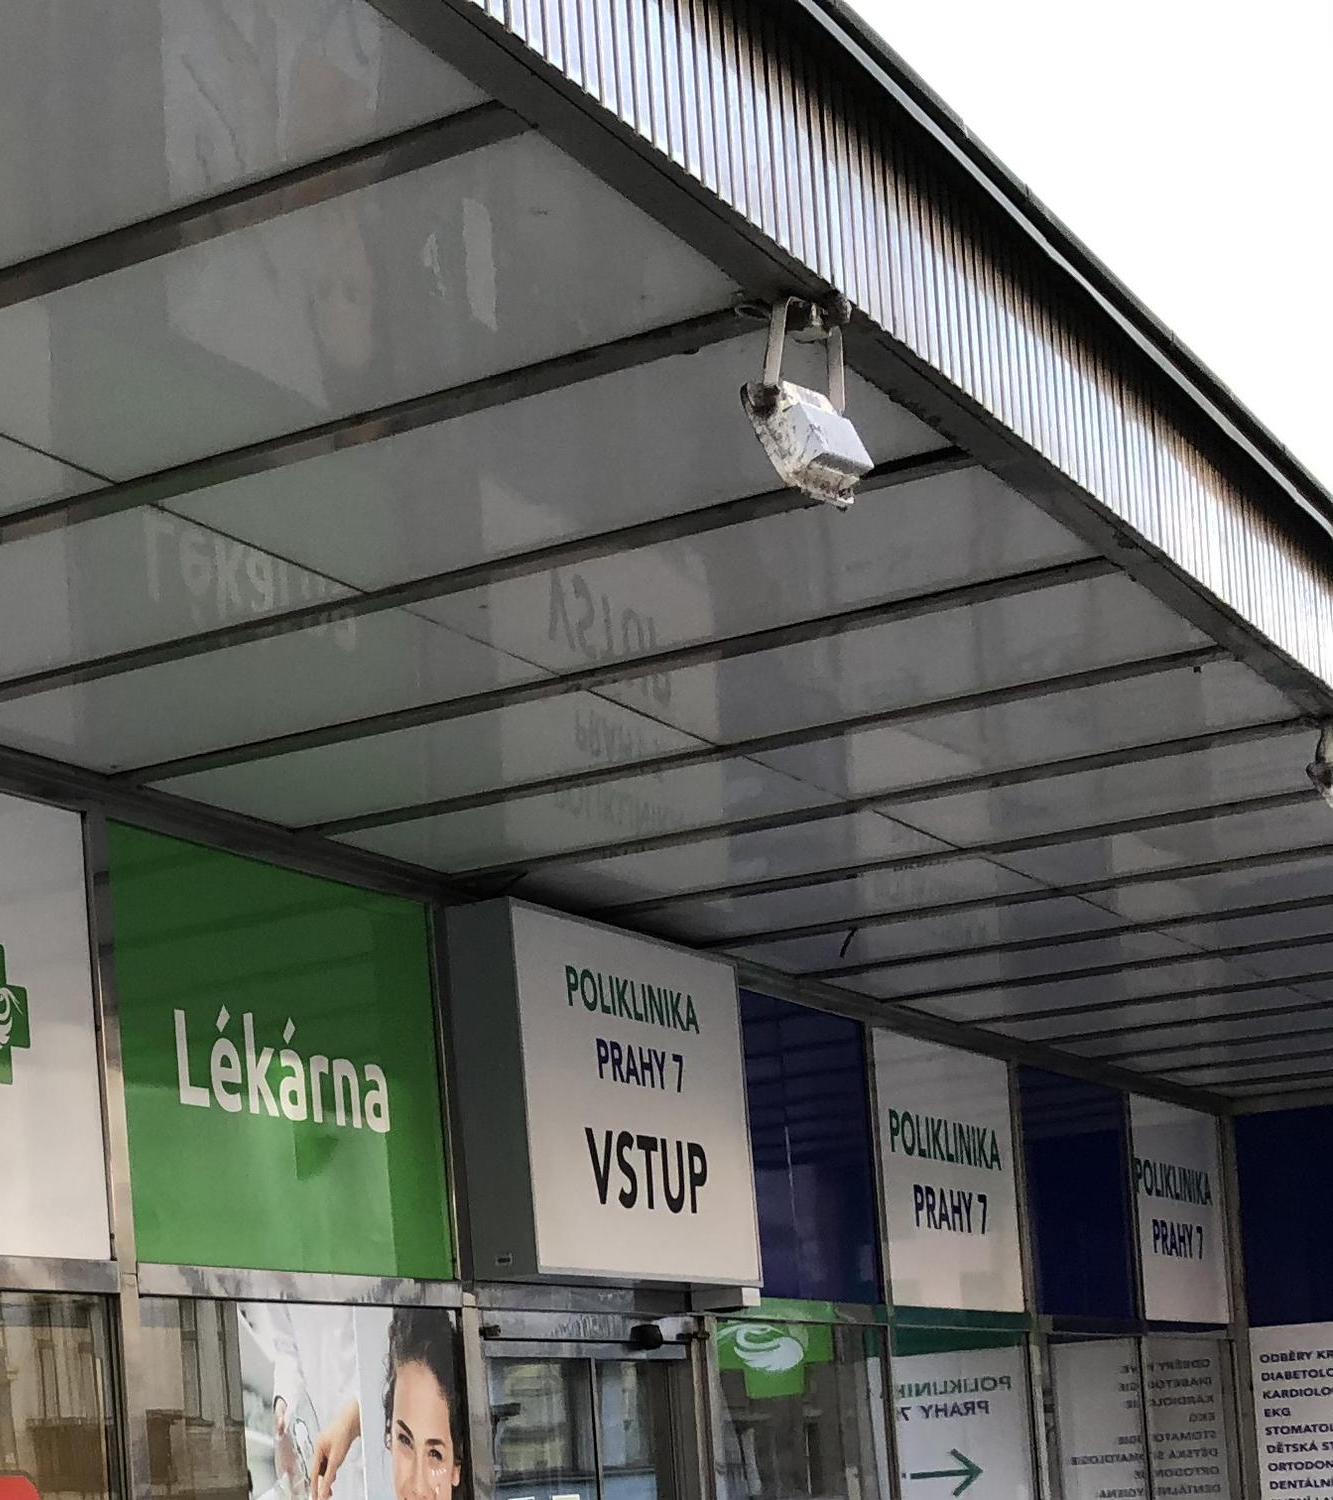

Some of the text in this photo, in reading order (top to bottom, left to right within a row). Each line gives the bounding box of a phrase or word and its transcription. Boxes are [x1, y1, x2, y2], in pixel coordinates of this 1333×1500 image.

[565, 964, 700, 1034] POLIKLINIKA
[174, 1004, 390, 1133] Lékárna
[596, 1038, 683, 1093] PRAHY 7
[888, 1108, 1002, 1171] POLIKLINIKA
[585, 1127, 707, 1214] VSTUP
[1134, 1157, 1213, 1207] POLIKLINIKA
[913, 1184, 987, 1235] PRAHY 7
[1152, 1218, 1203, 1259] PRAHY 7
[1262, 1386, 1333, 1399] KARDIOLO
[1264, 1407, 1291, 1417] EKG
[1266, 1440, 1318, 1454] DĚTSKÁ
